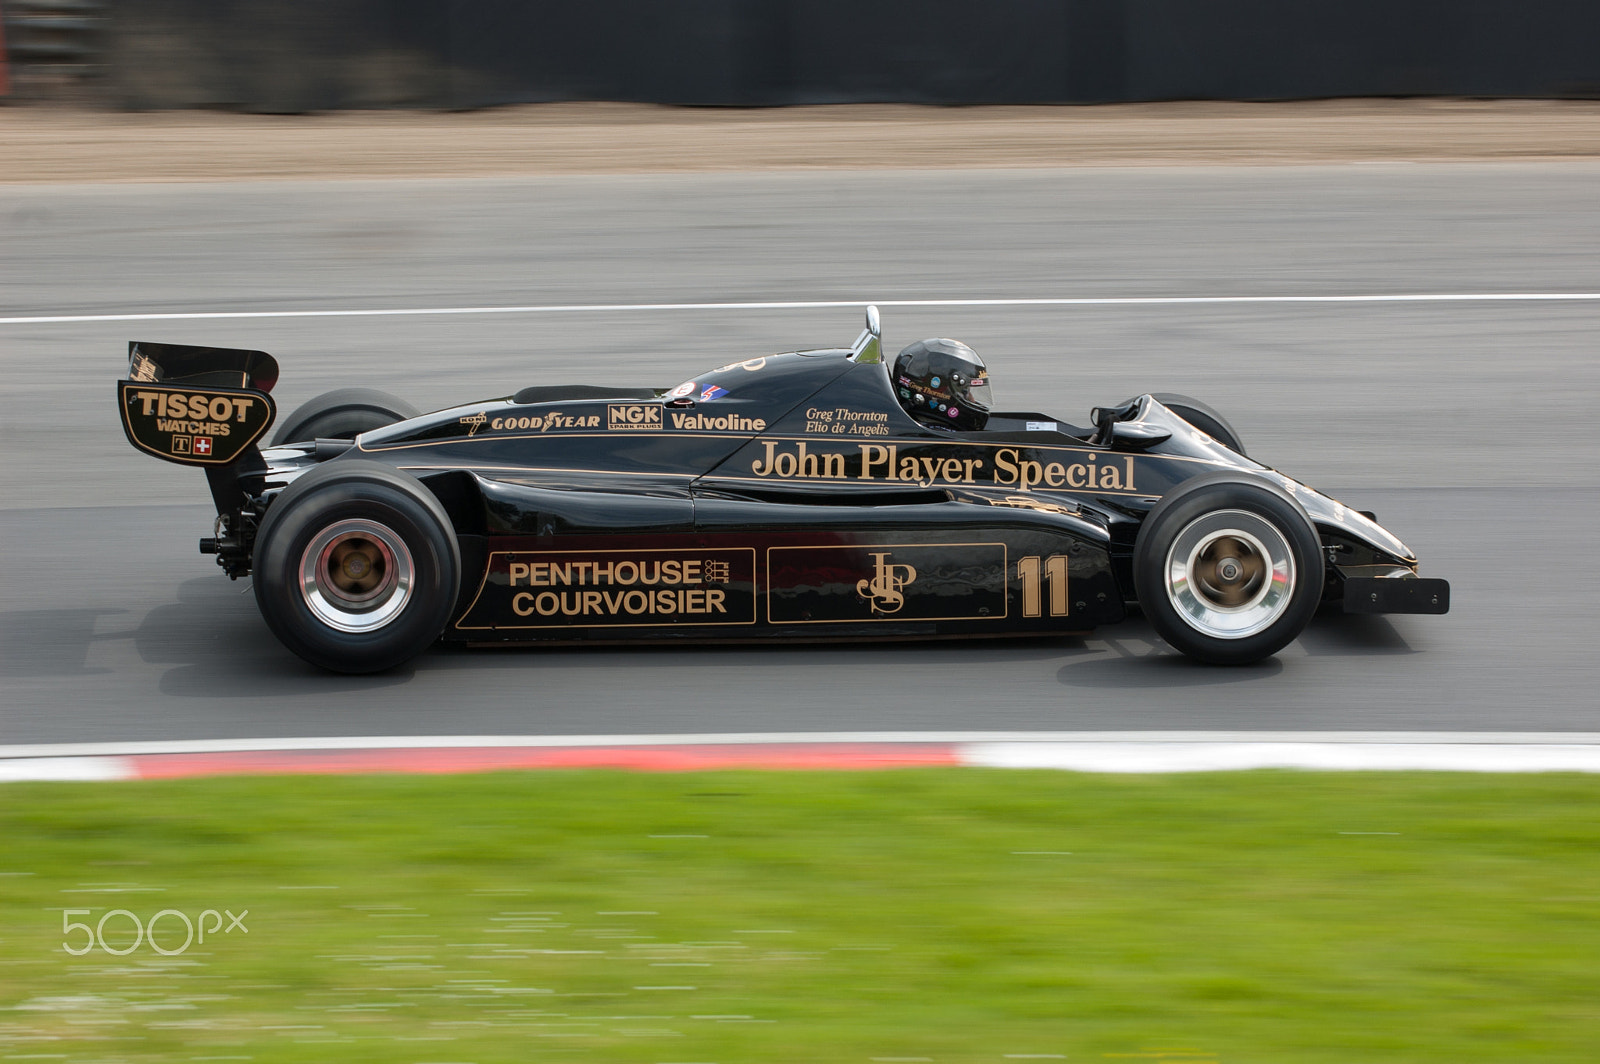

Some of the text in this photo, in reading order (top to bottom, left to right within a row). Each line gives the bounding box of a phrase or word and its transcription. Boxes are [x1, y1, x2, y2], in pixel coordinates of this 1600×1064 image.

[137, 391, 253, 423] TISSOT
[611, 406, 660, 423] NGK
[806, 408, 888, 422] Greg Thornton
[156, 418, 231, 437] WATCHES
[671, 413, 767, 431] Valvoline
[805, 421, 890, 437] Elio de Angelis
[752, 441, 1137, 492] John Player Special
[509, 560, 702, 587] PENTHOUSE
[1017, 555, 1069, 618] 11
[512, 589, 727, 616] COURVOISIER
